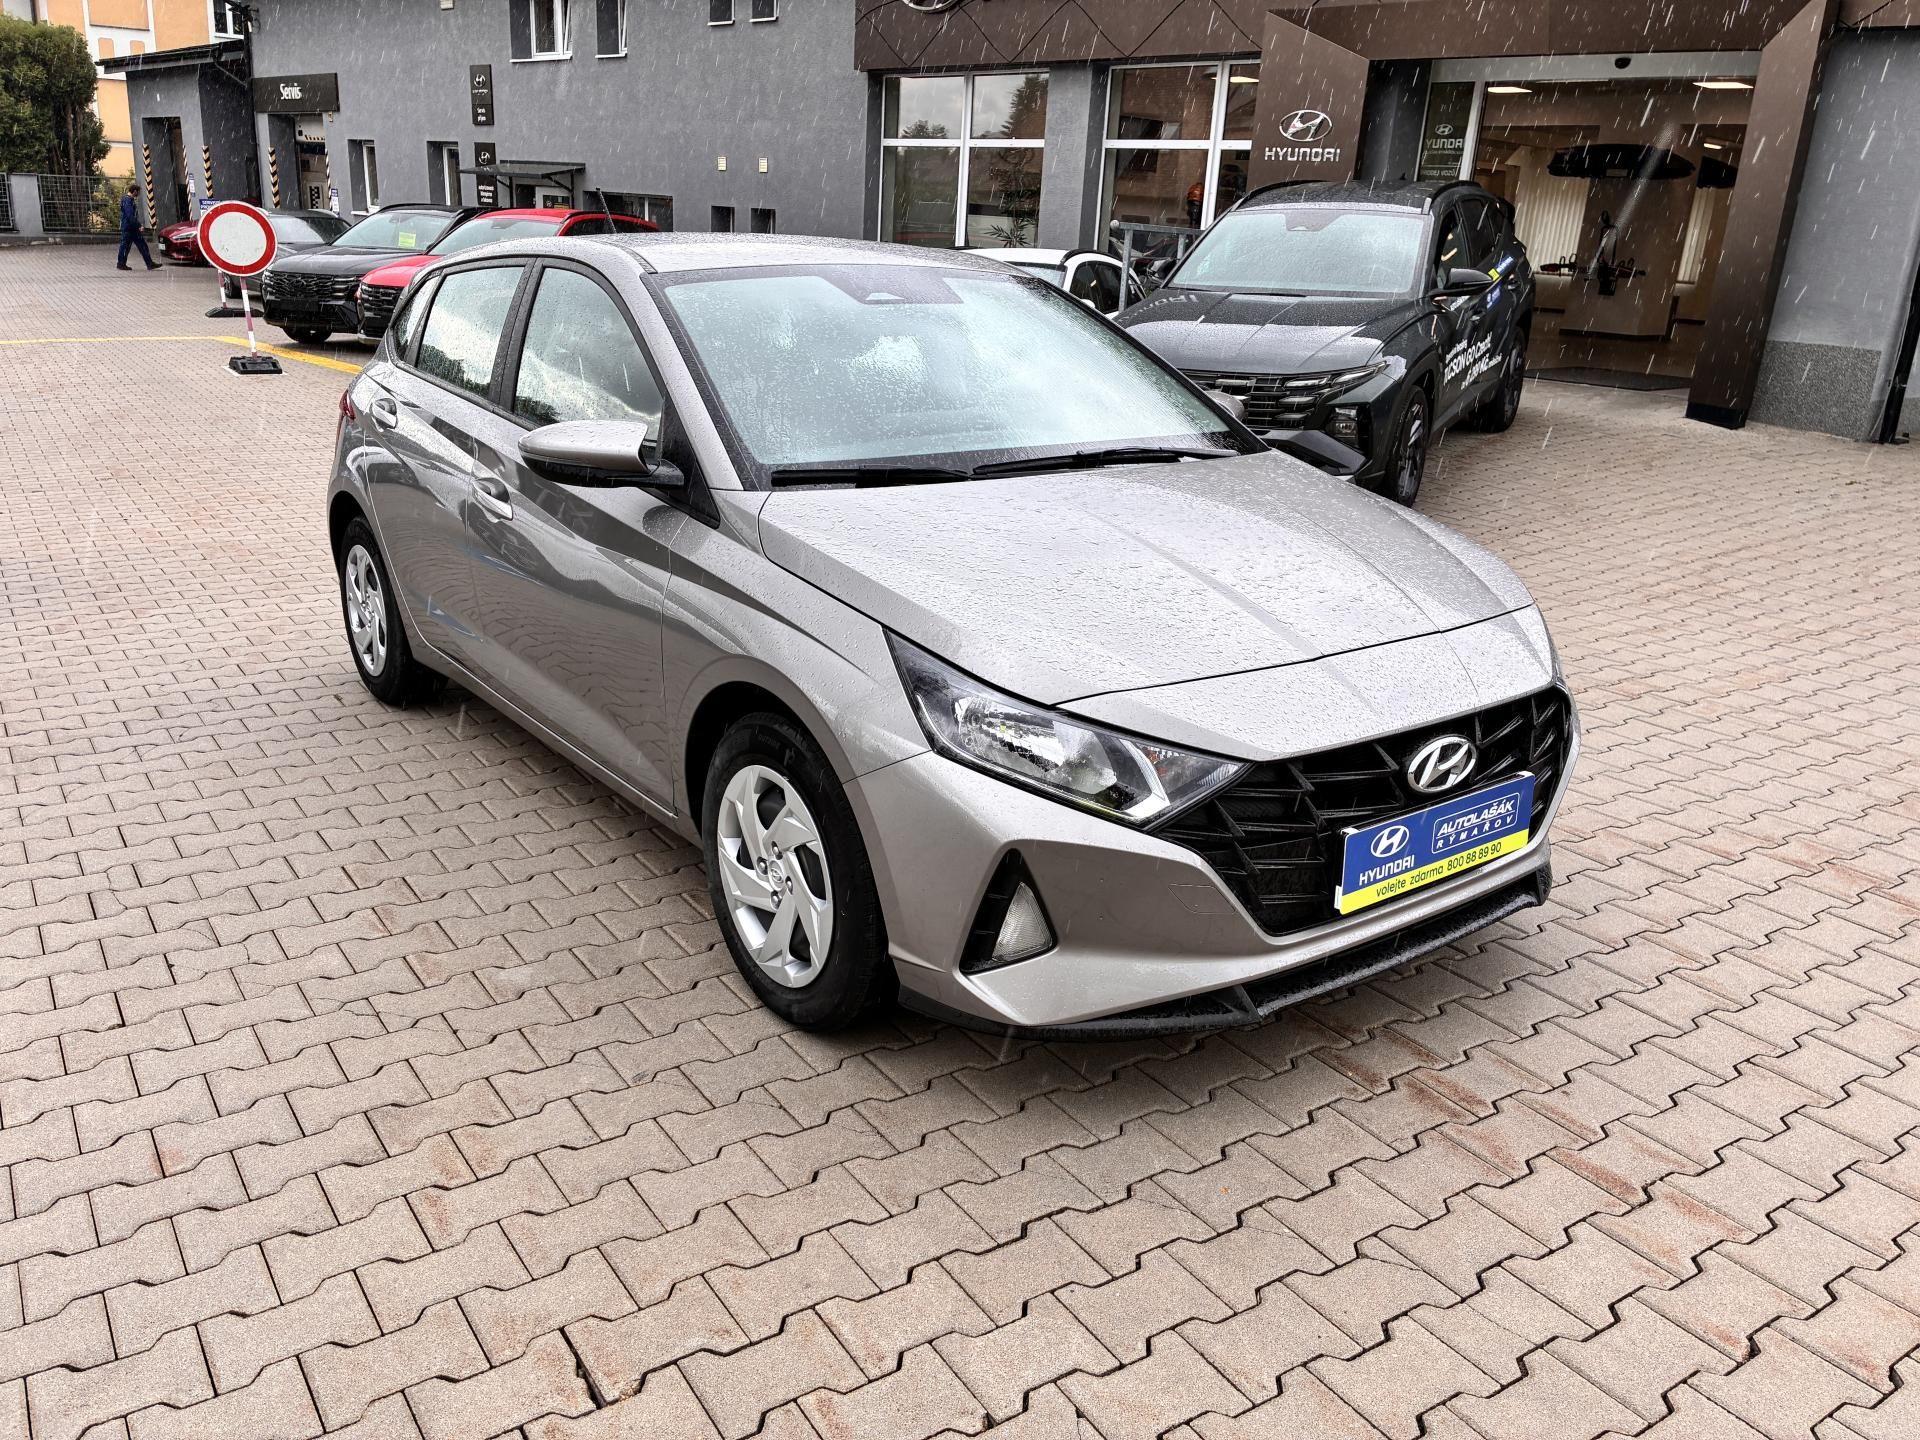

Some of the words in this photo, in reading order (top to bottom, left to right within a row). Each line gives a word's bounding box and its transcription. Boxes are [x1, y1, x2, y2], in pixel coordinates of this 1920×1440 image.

[280, 82, 302, 100] Servis
[1264, 147, 1341, 162] HYUNDAI
[1426, 138, 1463, 149] YUNDA
[1436, 815, 1514, 849] RÝMAŘOV
[1437, 799, 1515, 837] AUTOLAŠÁK
[1359, 854, 1415, 886] HYUNDAI
[1376, 879, 1407, 898] volejte
[1409, 866, 1444, 886] zdarma
[1447, 855, 1465, 872] 800
[1465, 850, 1478, 864] 88
[1478, 847, 1490, 861] 89
[1490, 841, 1502, 856] 90
